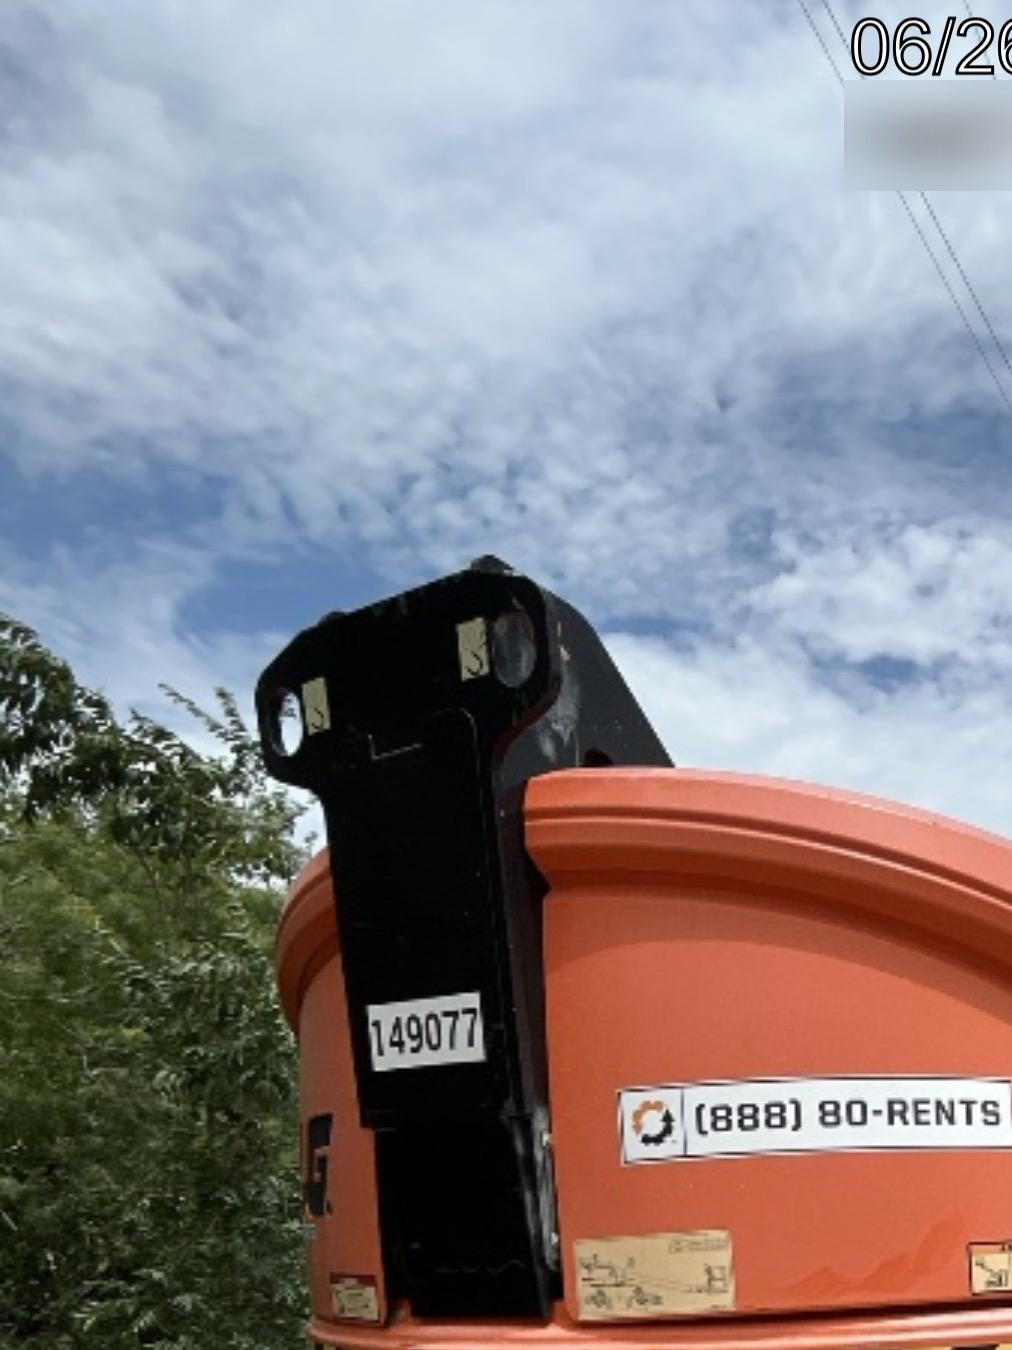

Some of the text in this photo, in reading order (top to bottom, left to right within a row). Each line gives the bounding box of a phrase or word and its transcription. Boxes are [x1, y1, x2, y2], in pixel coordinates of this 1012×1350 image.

[370, 1007, 478, 1057] 149077
[695, 1098, 1001, 1136] (888) 80-RENTS
